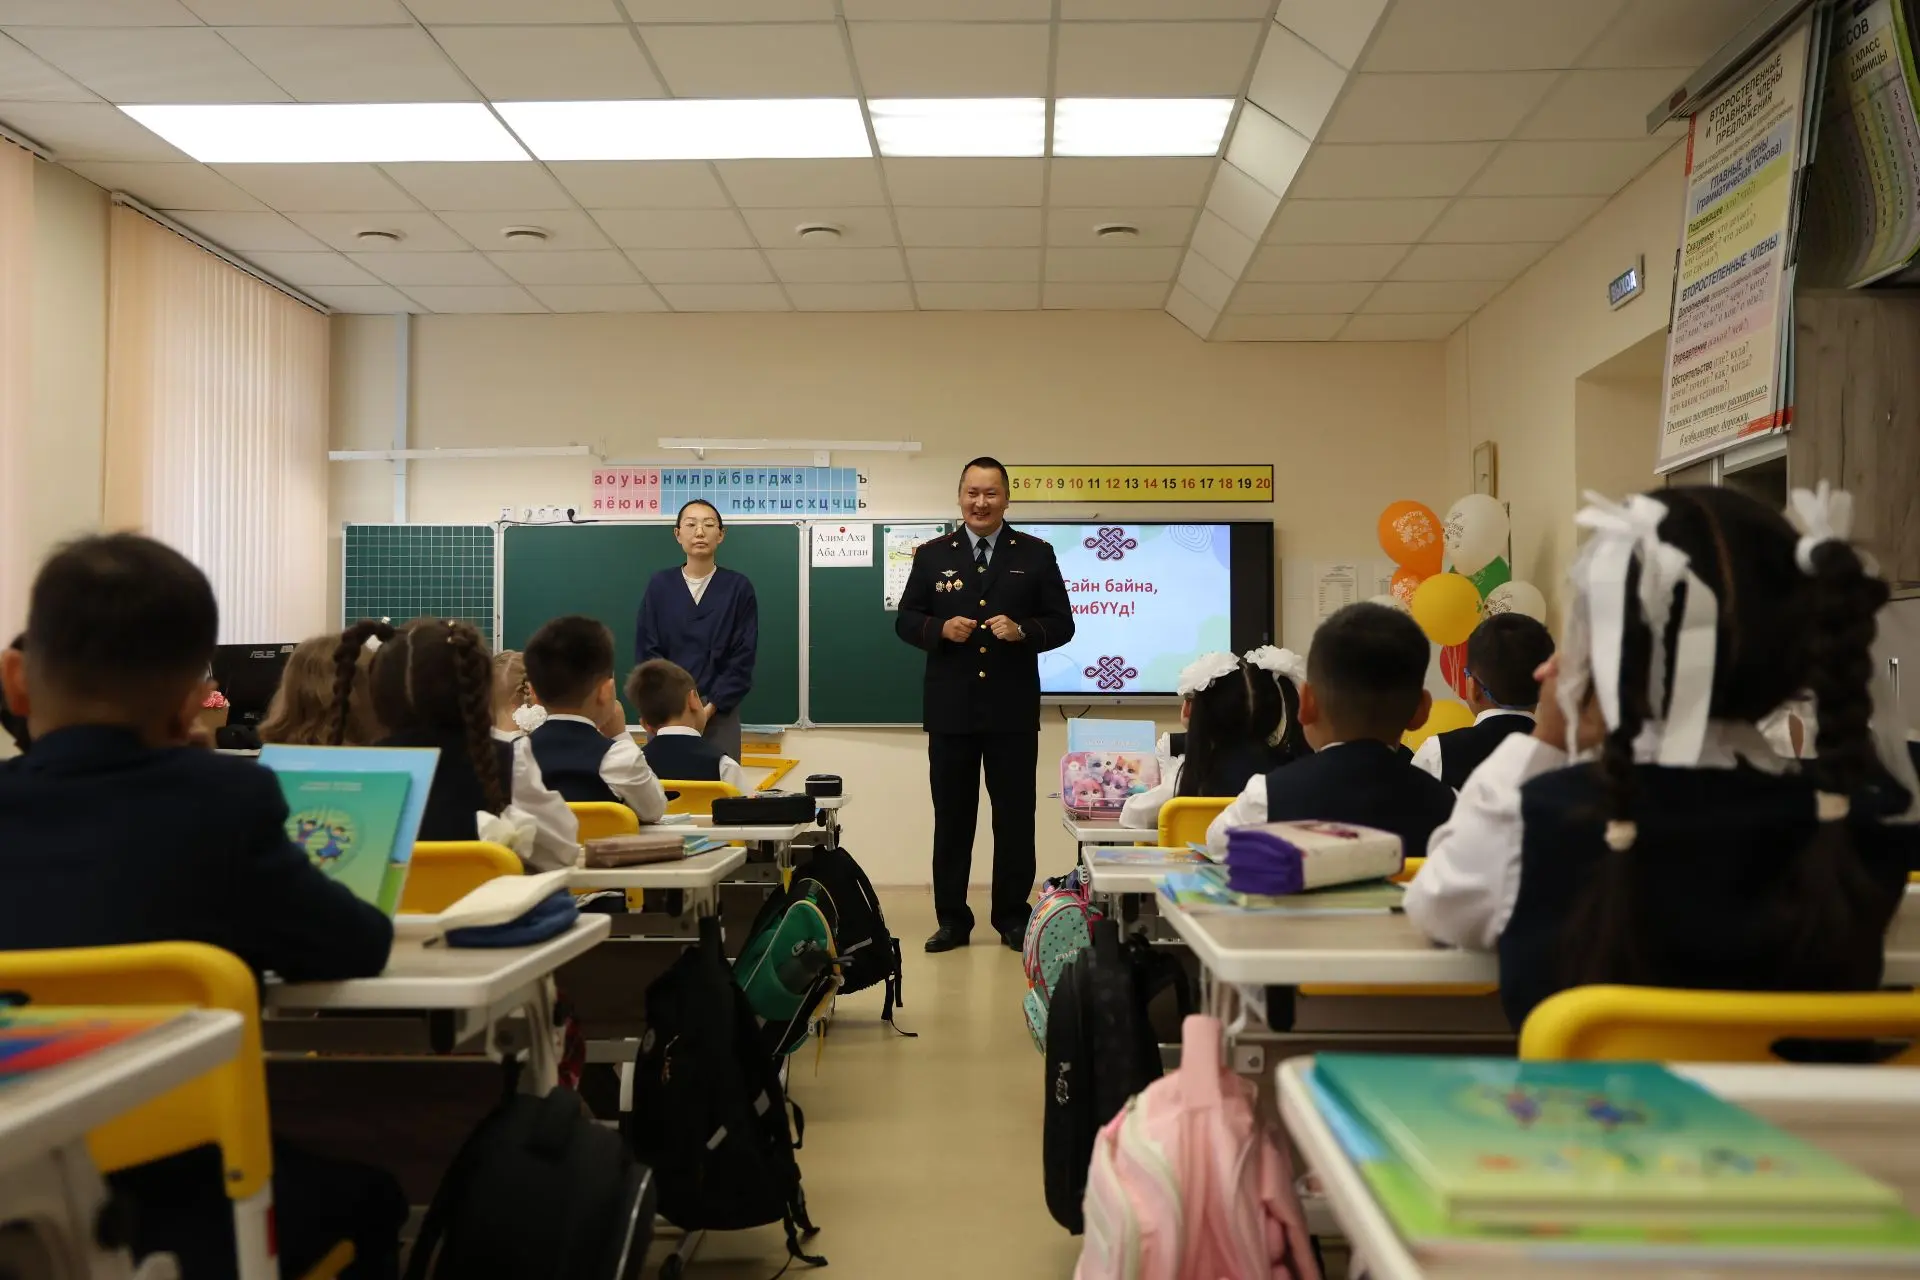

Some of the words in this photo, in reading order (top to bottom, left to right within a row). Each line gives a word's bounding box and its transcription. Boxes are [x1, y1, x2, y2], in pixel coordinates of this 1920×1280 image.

[1856, 37, 1881, 62] КЛАСС
[1850, 49, 1888, 82] ЕДИНИЦЫ
[1705, 125, 1711, 139] И
[1715, 94, 1752, 132] ГЛАВНЫЕ
[1757, 66, 1783, 97] ЧЛЕНЫ
[1709, 53, 1782, 123] ВТОРОСТЕПЕННЫЕ
[1715, 90, 1773, 145] ПРЕДЛОЖЕНИЯ
[1710, 156, 1743, 190] ГЛАВНЫЕ
[1746, 135, 1769, 163] ЧЛЕНЫ
[1682, 251, 1748, 302] ВТОРОСТЕПЕННЫЕ
[1750, 232, 1778, 260] ЧЛЕНЫ
[1012, 477, 1020, 490] 5
[1023, 477, 1032, 490] 6
[1034, 477, 1043, 490] 7
[1046, 477, 1054, 490] 8
[1056, 477, 1065, 490] 9
[1068, 477, 1084, 490] 10
[1087, 477, 1101, 490] 11
[1105, 477, 1121, 490] 12
[1124, 477, 1140, 490] 13
[1143, 477, 1159, 490] 14
[1161, 477, 1177, 490] 15
[1180, 477, 1196, 490] 16
[1199, 477, 1215, 490] 17
[1218, 477, 1234, 490] 18
[1237, 477, 1253, 490] 19
[1255, 477, 1271, 490] 20
[816, 532, 844, 542] Алим
[846, 532, 866, 542] Аха
[816, 547, 836, 557] Аба
[838, 547, 869, 557] Алтан
[1063, 578, 1100, 593] Сайн
[1105, 578, 1158, 595] байна,
[249, 650, 275, 659] ASUS
